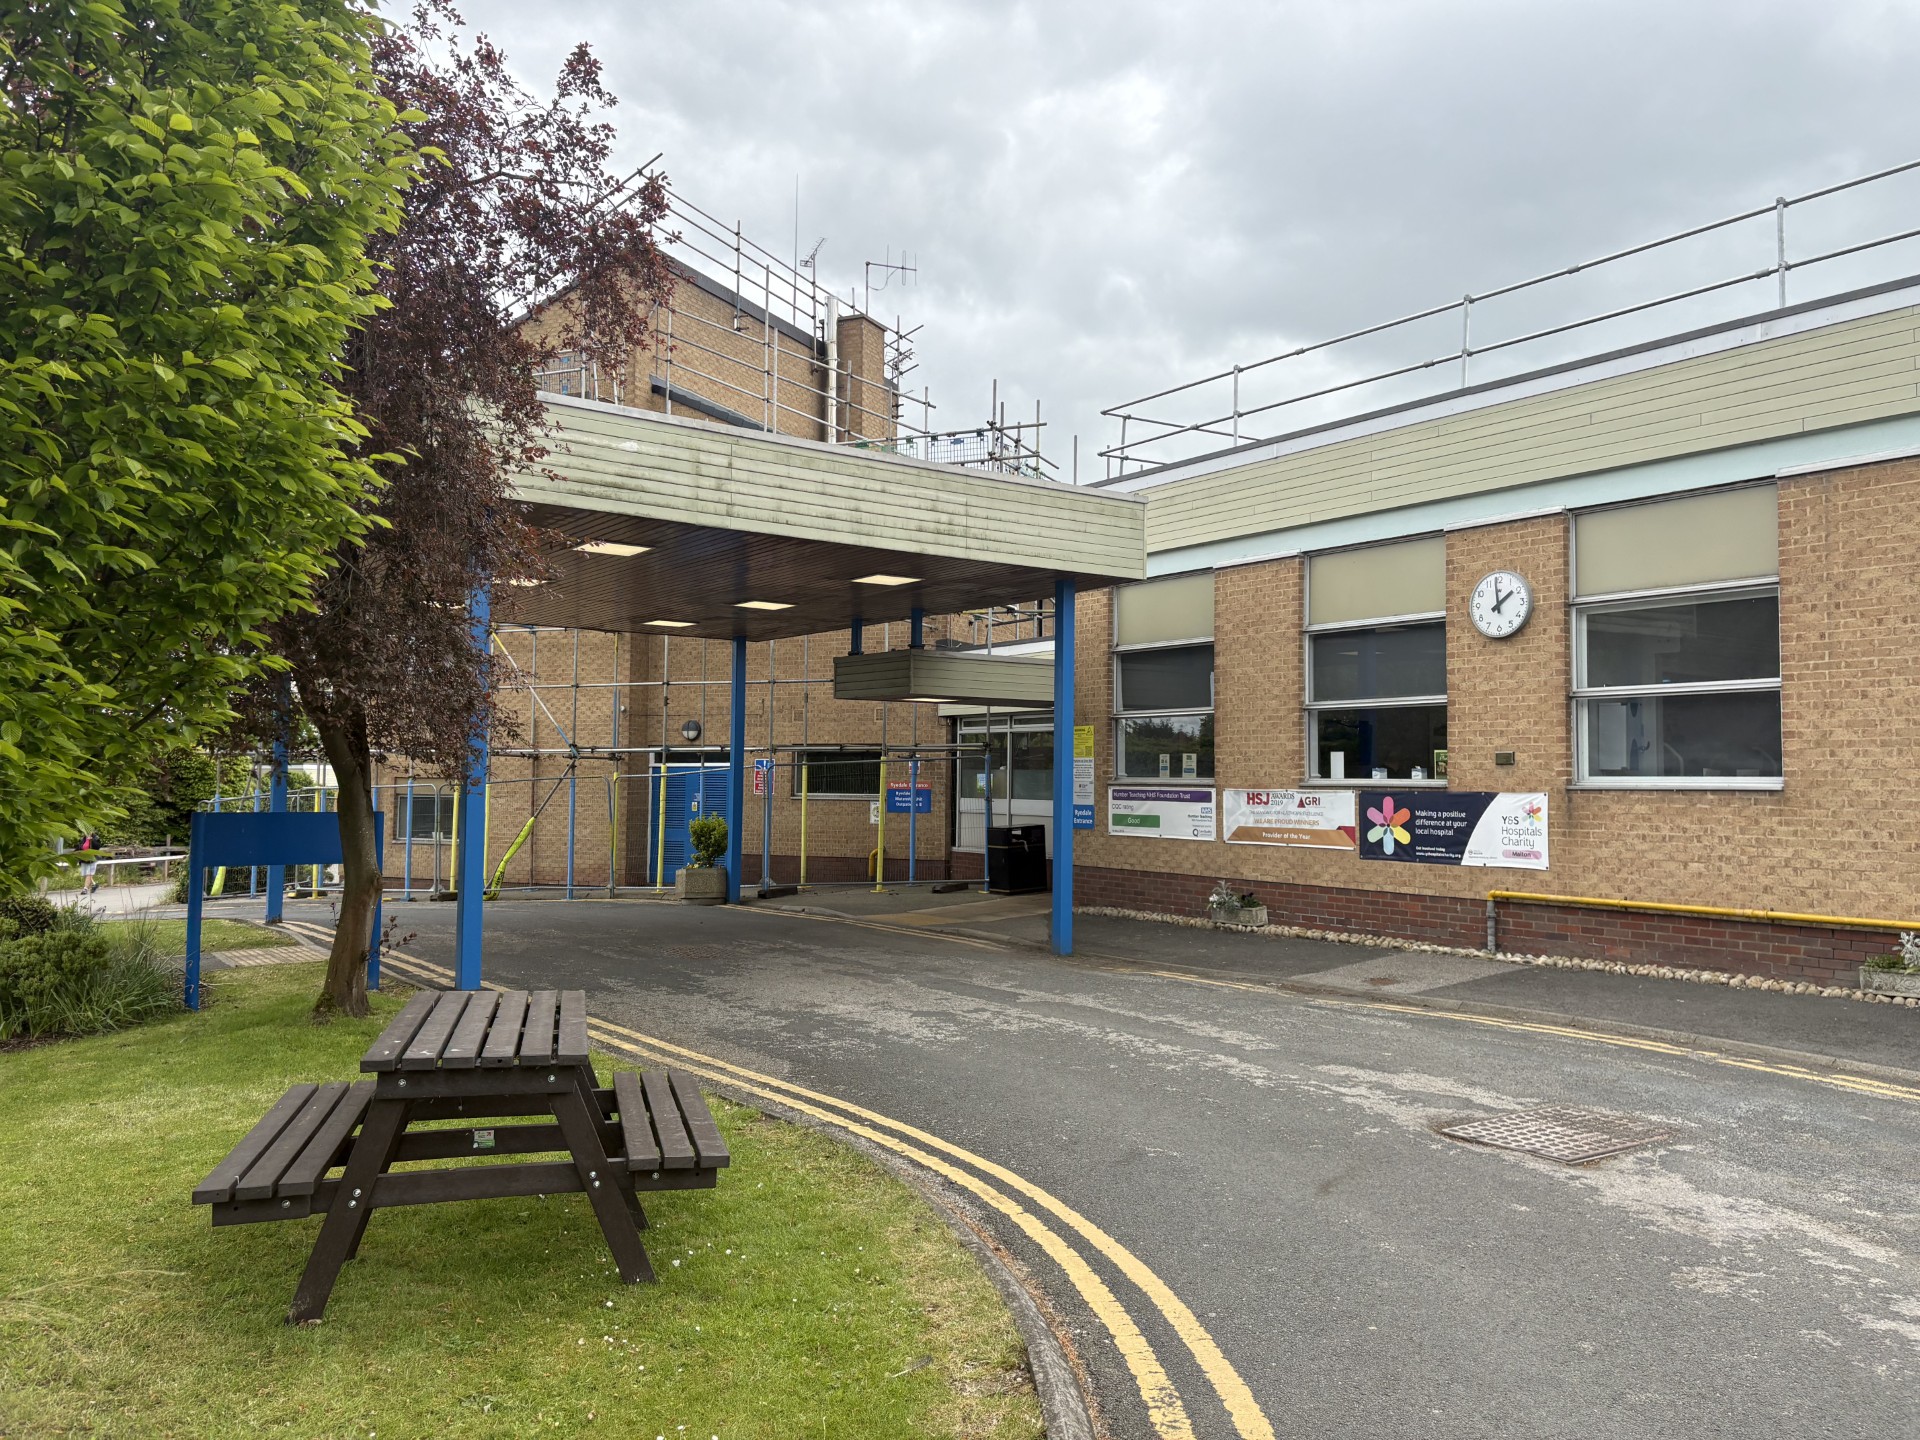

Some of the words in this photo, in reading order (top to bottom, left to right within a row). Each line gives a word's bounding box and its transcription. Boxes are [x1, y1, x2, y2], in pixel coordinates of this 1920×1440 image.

[1486, 580, 1491, 589] 11
[1477, 590, 1485, 598] 10
[1515, 586, 1522, 594] 2
[1475, 602, 1481, 610] 9
[1519, 598, 1525, 606] 3
[1478, 614, 1484, 622] 8
[1486, 622, 1491, 630] 7
[1508, 620, 1514, 628] 5
[1247, 792, 1270, 806] HSJ
[1271, 792, 1295, 800] AWARDS
[1074, 809, 1092, 817] Ryedale
[1415, 810, 1436, 818] Making
[1415, 818, 1445, 826] difference
[1501, 815, 1519, 825] Y&S
[1262, 831, 1282, 839] Provider
[1430, 828, 1454, 837] hospital
[1501, 826, 1543, 838] Hospitals
[1501, 836, 1535, 850] Charity
